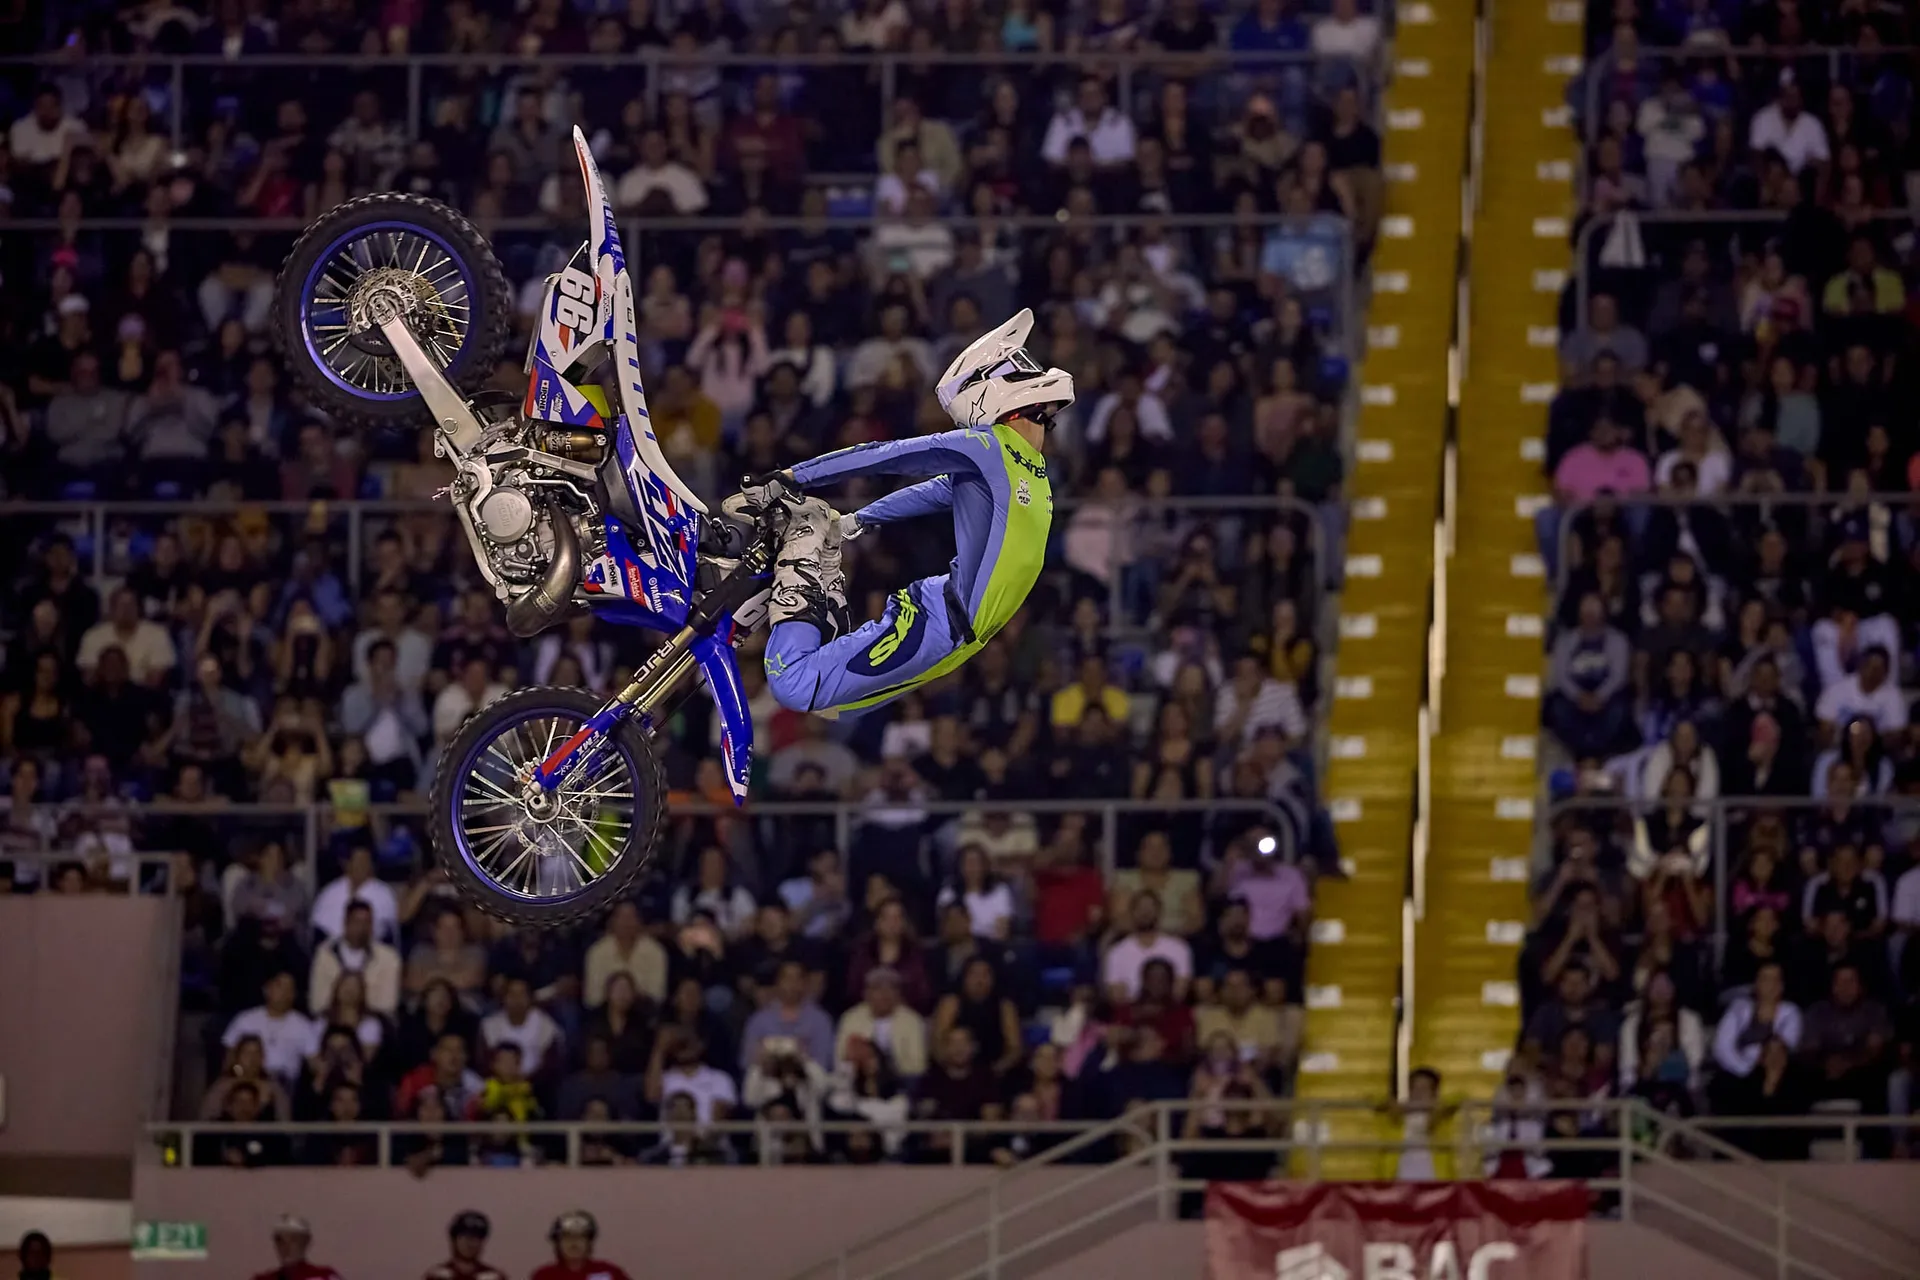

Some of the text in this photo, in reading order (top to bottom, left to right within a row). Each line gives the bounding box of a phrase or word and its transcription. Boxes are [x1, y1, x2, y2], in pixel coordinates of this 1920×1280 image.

[556, 267, 595, 335] 66
[538, 387, 549, 411] IPONE
[564, 431, 573, 451] RJC
[609, 562, 619, 588] IPONE
[649, 584, 664, 614] YAMAHA
[633, 640, 675, 683] RJC
[577, 730, 600, 755] FMX
[1362, 1240, 1519, 1280] BAC
